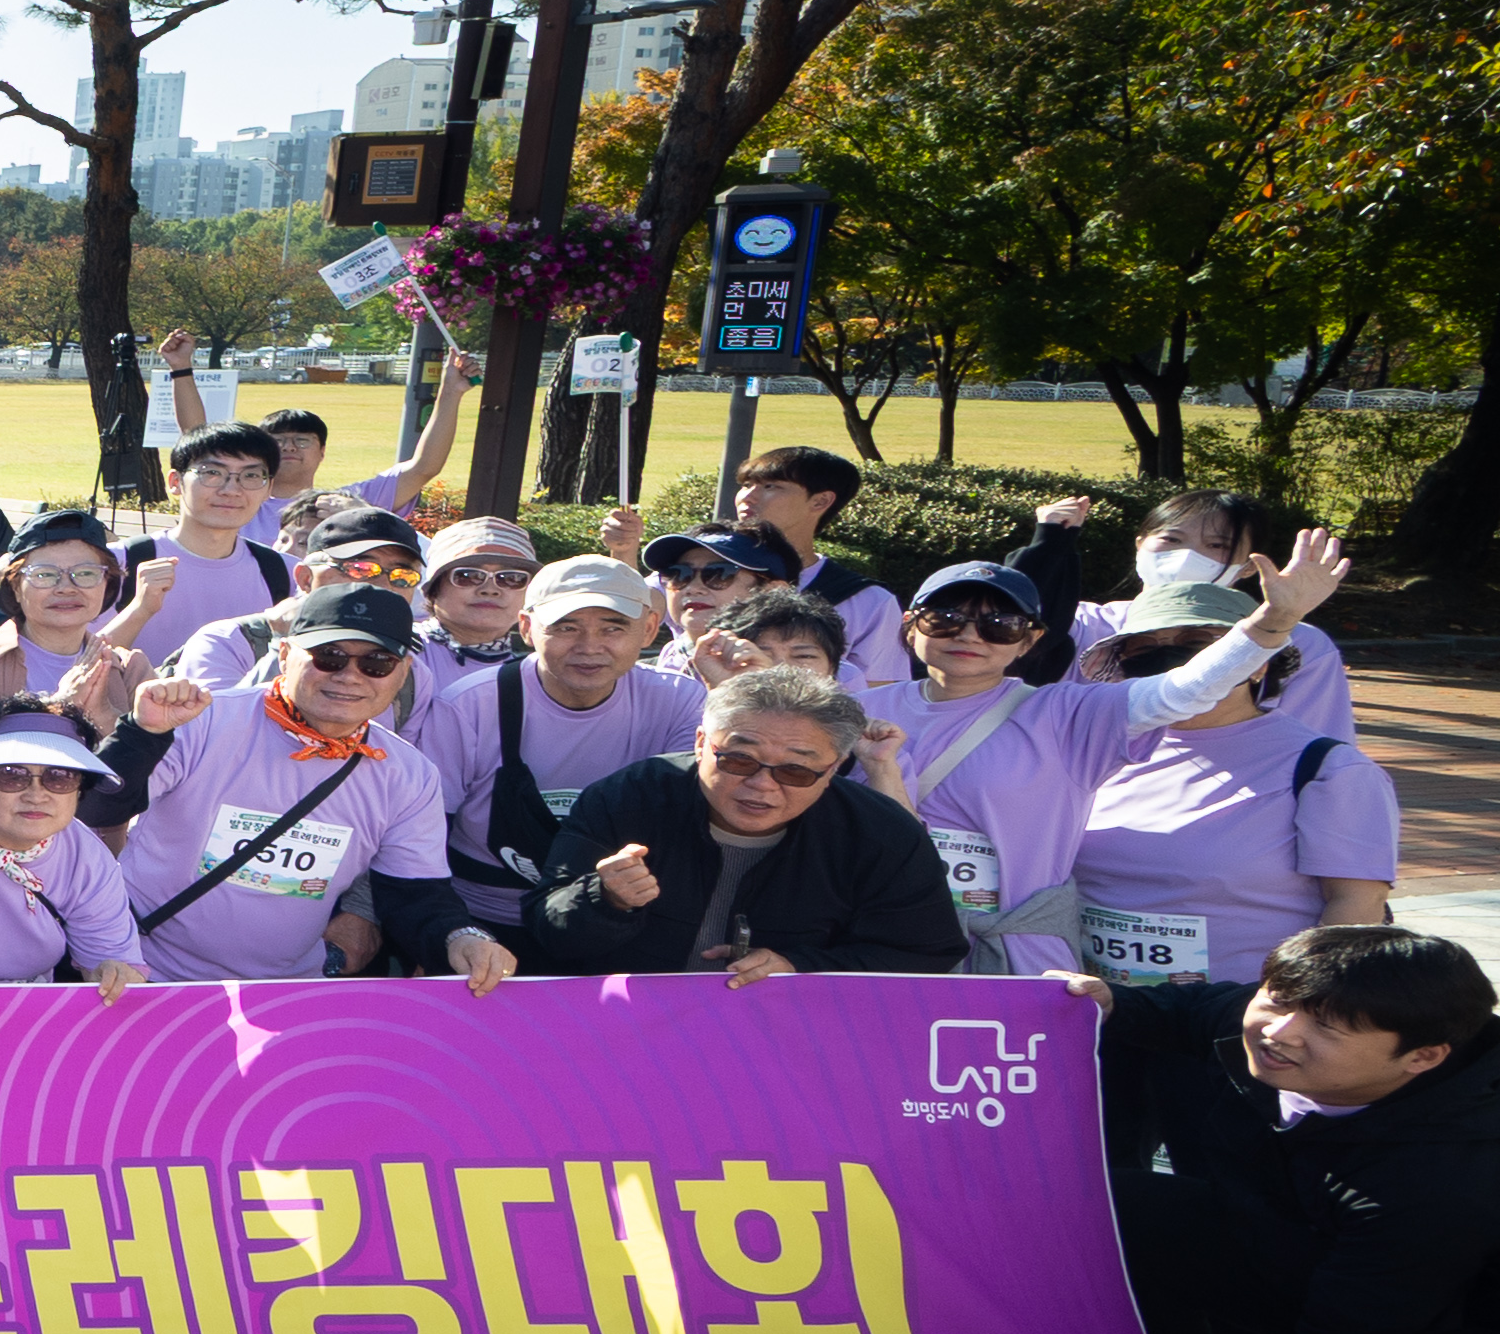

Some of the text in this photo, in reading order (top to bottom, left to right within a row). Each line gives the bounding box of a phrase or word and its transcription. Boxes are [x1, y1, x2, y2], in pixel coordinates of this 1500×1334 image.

[725, 281, 790, 299] 초미세
[723, 301, 787, 320] 먼 지
[726, 328, 776, 347] 좋음
[290, 830, 342, 848] 트레킹대회
[1132, 924, 1197, 938] 트레킹대회
[1091, 934, 1174, 965] 0518
[901, 1098, 970, 1124] 희망도시
